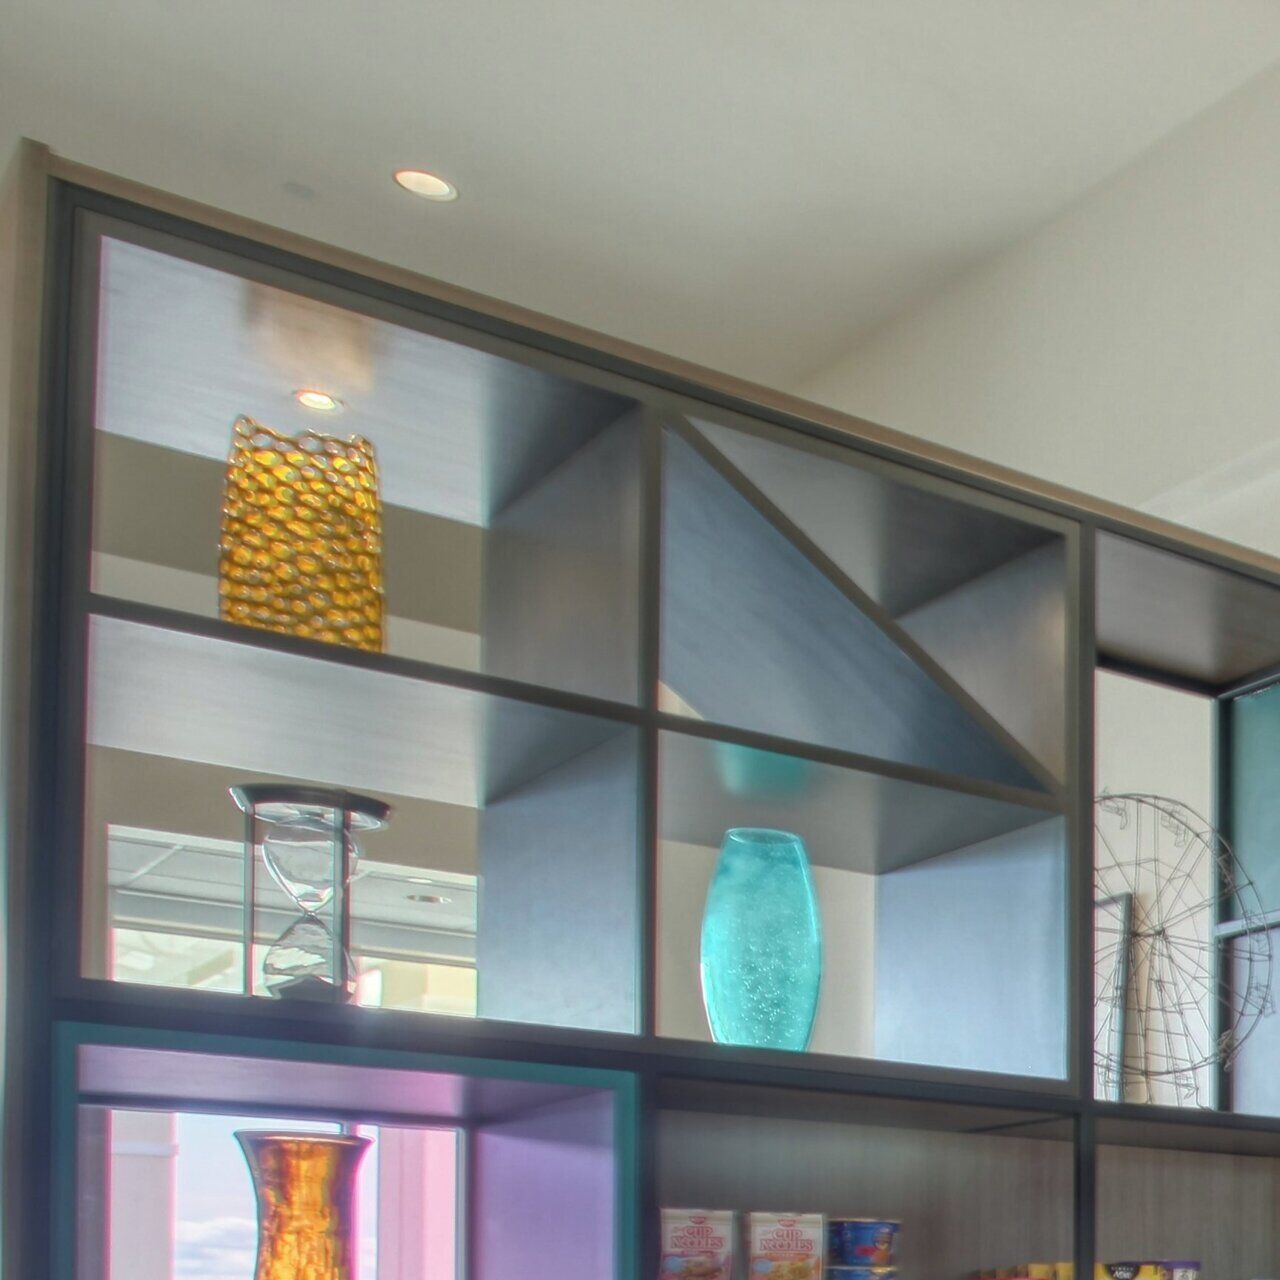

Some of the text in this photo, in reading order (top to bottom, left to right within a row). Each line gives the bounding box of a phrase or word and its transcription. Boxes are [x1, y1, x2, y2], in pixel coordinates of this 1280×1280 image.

[683, 1226, 713, 1238] CUP
[772, 1229, 802, 1242] CUP
[671, 1236, 725, 1250] NOODLES
[760, 1239, 813, 1251] NOODLES
